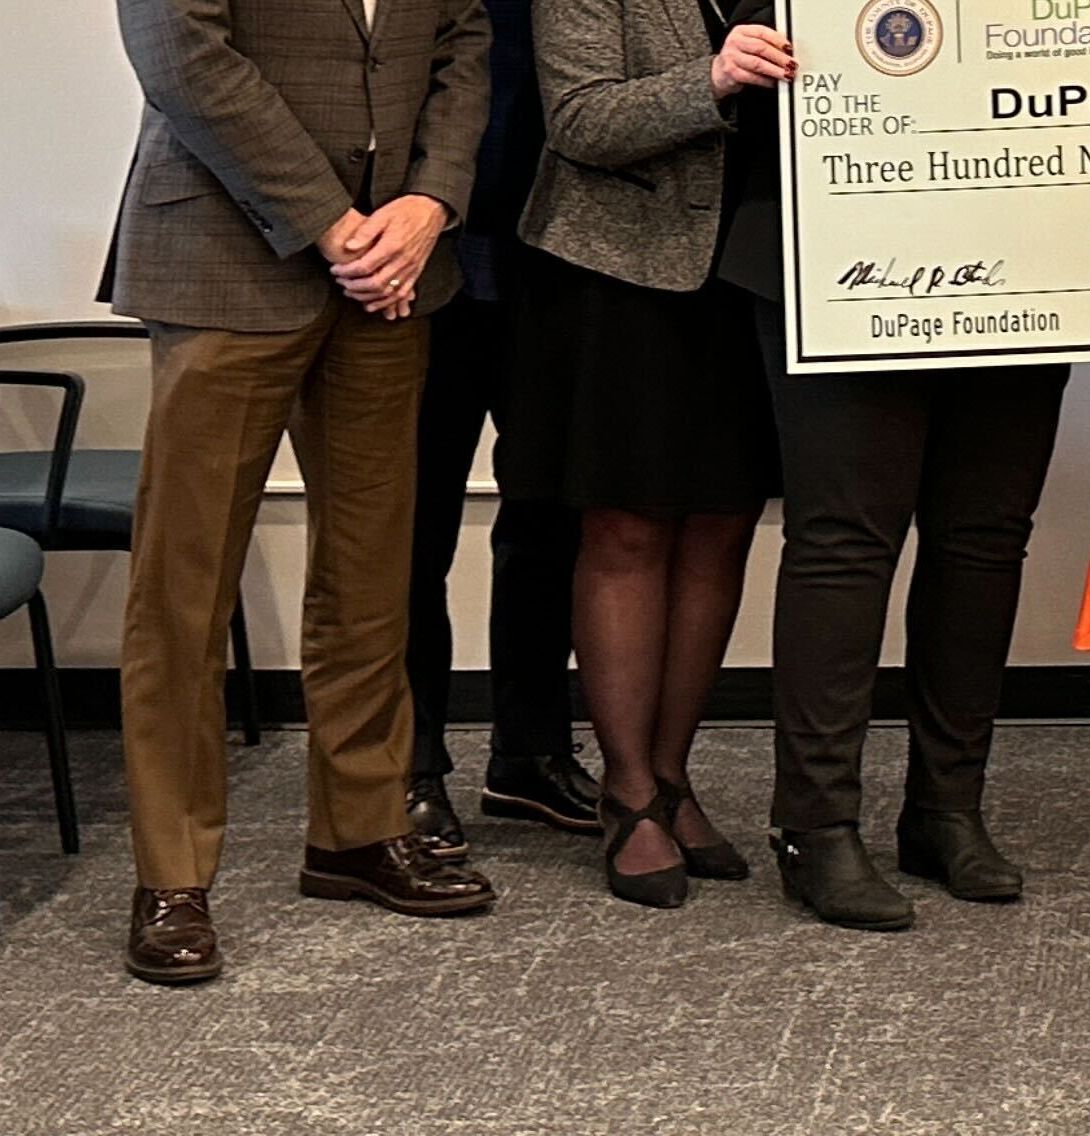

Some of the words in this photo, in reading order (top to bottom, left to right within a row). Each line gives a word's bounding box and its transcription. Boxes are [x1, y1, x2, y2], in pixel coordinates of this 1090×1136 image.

[986, 50, 1014, 61] Doing
[1015, 51, 1022, 59] a
[1064, 46, 1088, 58] good
[802, 73, 842, 93] PAY
[803, 95, 832, 114] TO
[842, 94, 881, 113] THE
[801, 117, 875, 137] ORDER
[822, 153, 914, 185] Three
[928, 144, 1066, 182] Hundred
[871, 313, 944, 344] DuPage
[953, 308, 1061, 336] Foundation
